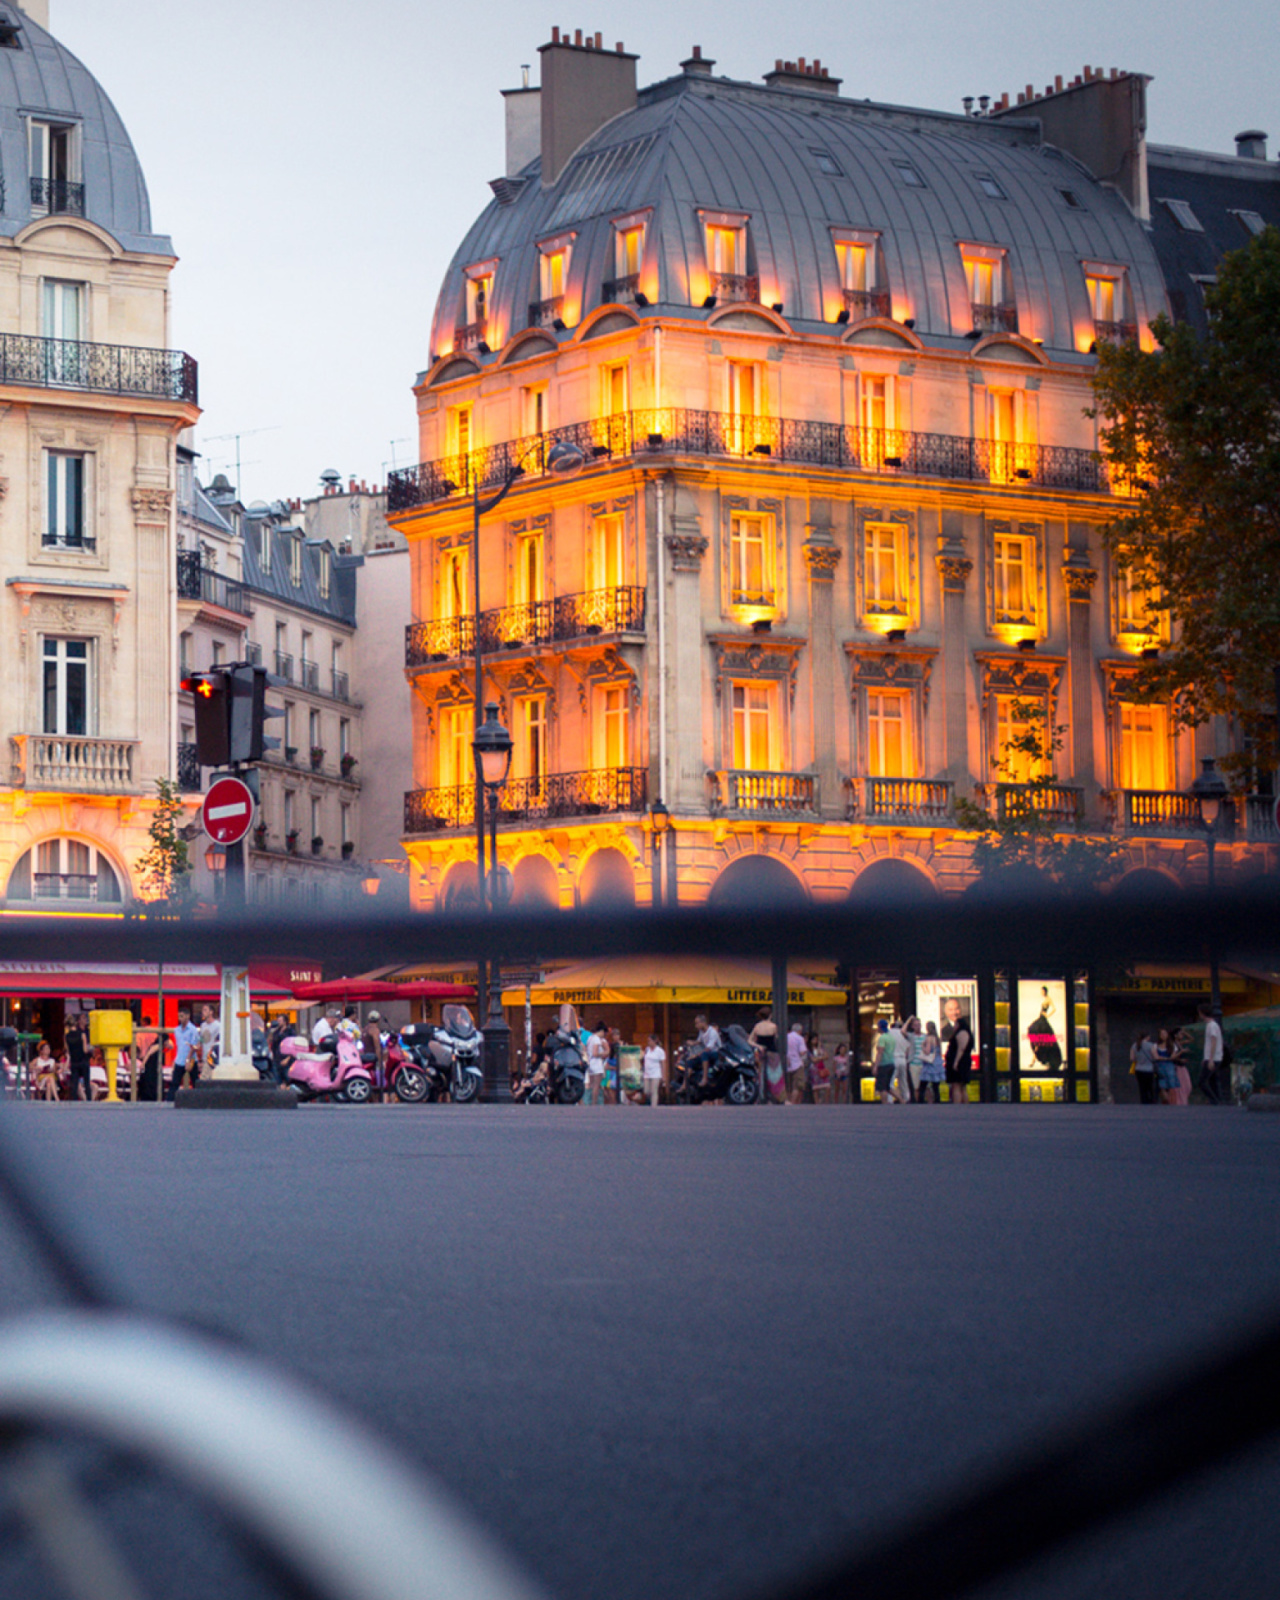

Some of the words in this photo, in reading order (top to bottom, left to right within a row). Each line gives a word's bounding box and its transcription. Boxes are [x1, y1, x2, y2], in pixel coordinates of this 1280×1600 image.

[290, 970, 312, 982] SAINT
[920, 983, 971, 996] WINNER
[1151, 979, 1204, 990] PAPETERIE
[553, 989, 610, 1003] PAPETERIE
[727, 990, 805, 1002] LITTERARE
